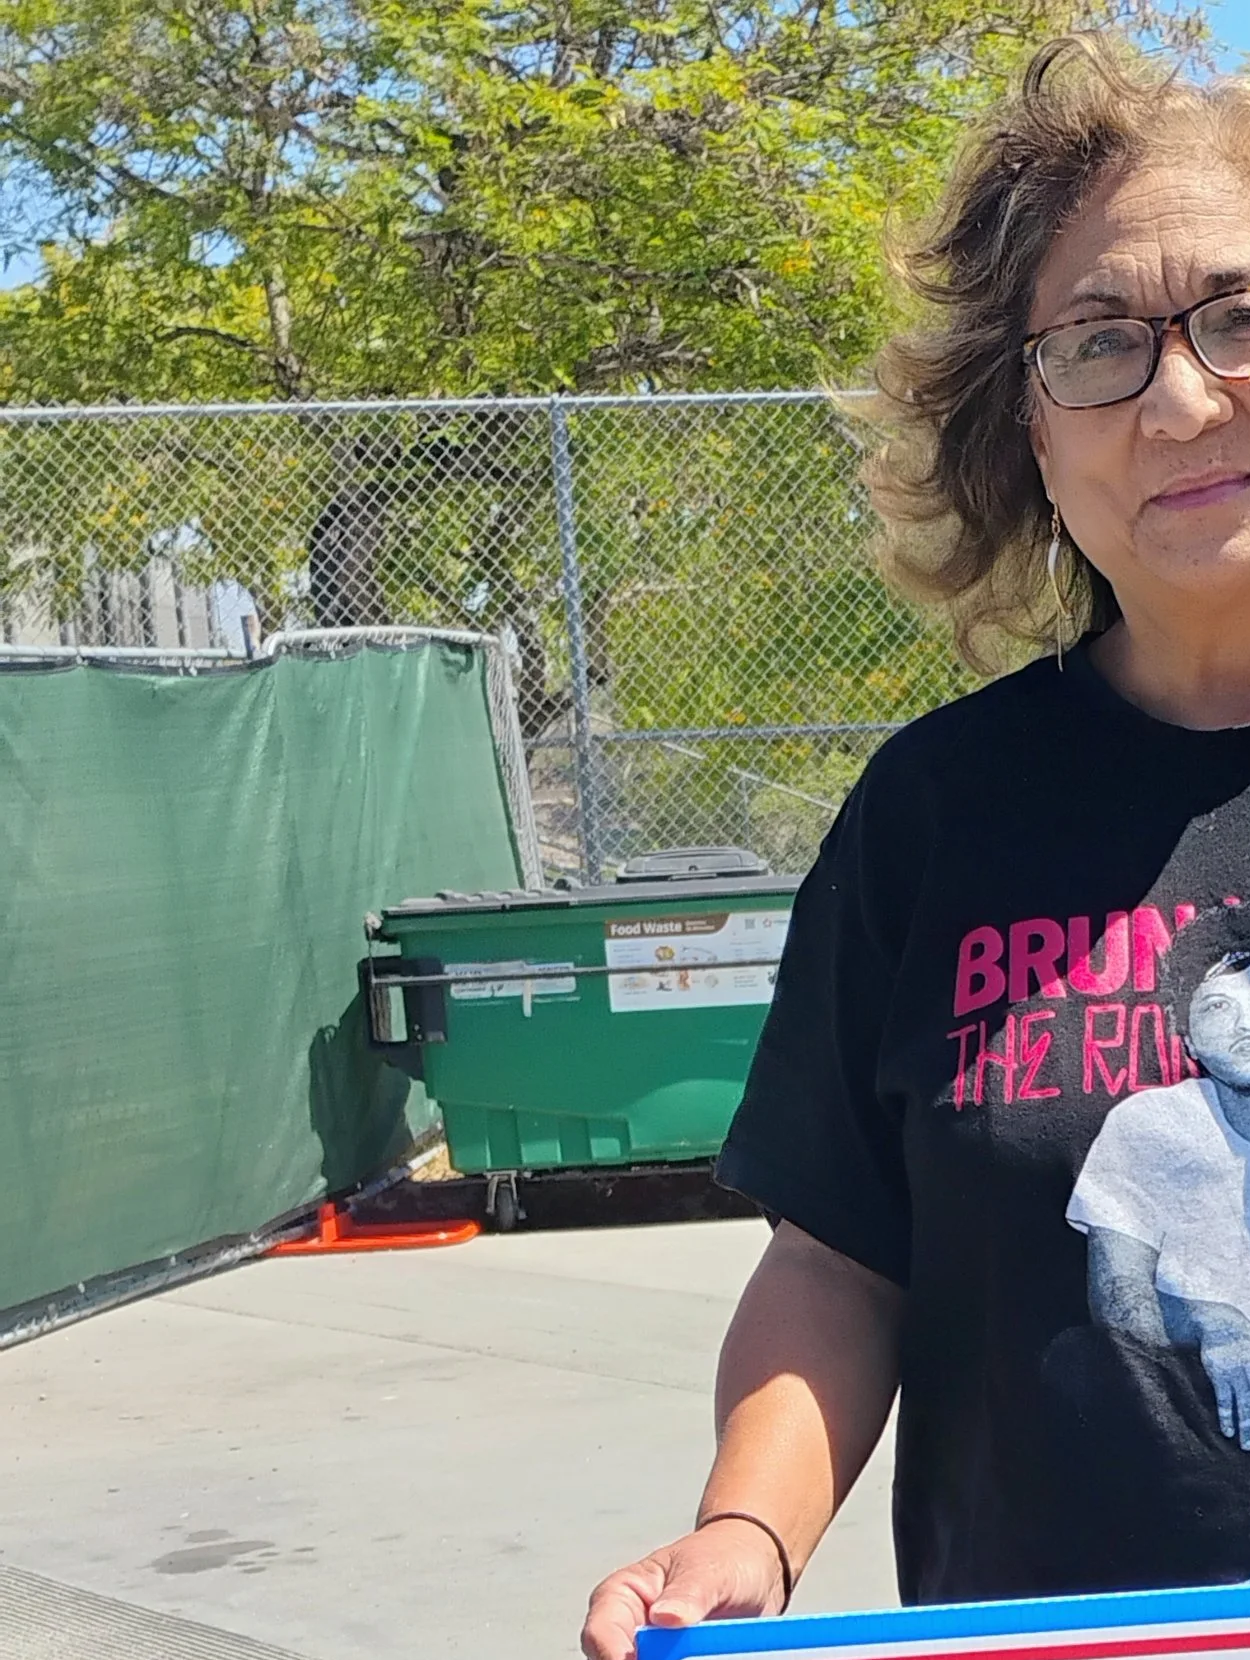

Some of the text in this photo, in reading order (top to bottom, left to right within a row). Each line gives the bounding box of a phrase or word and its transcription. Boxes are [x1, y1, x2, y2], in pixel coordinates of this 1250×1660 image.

[610, 923, 641, 937] Food
[643, 921, 682, 934] Waste
[953, 898, 1238, 1018] BRUN
[946, 1011, 1062, 1112] THE
